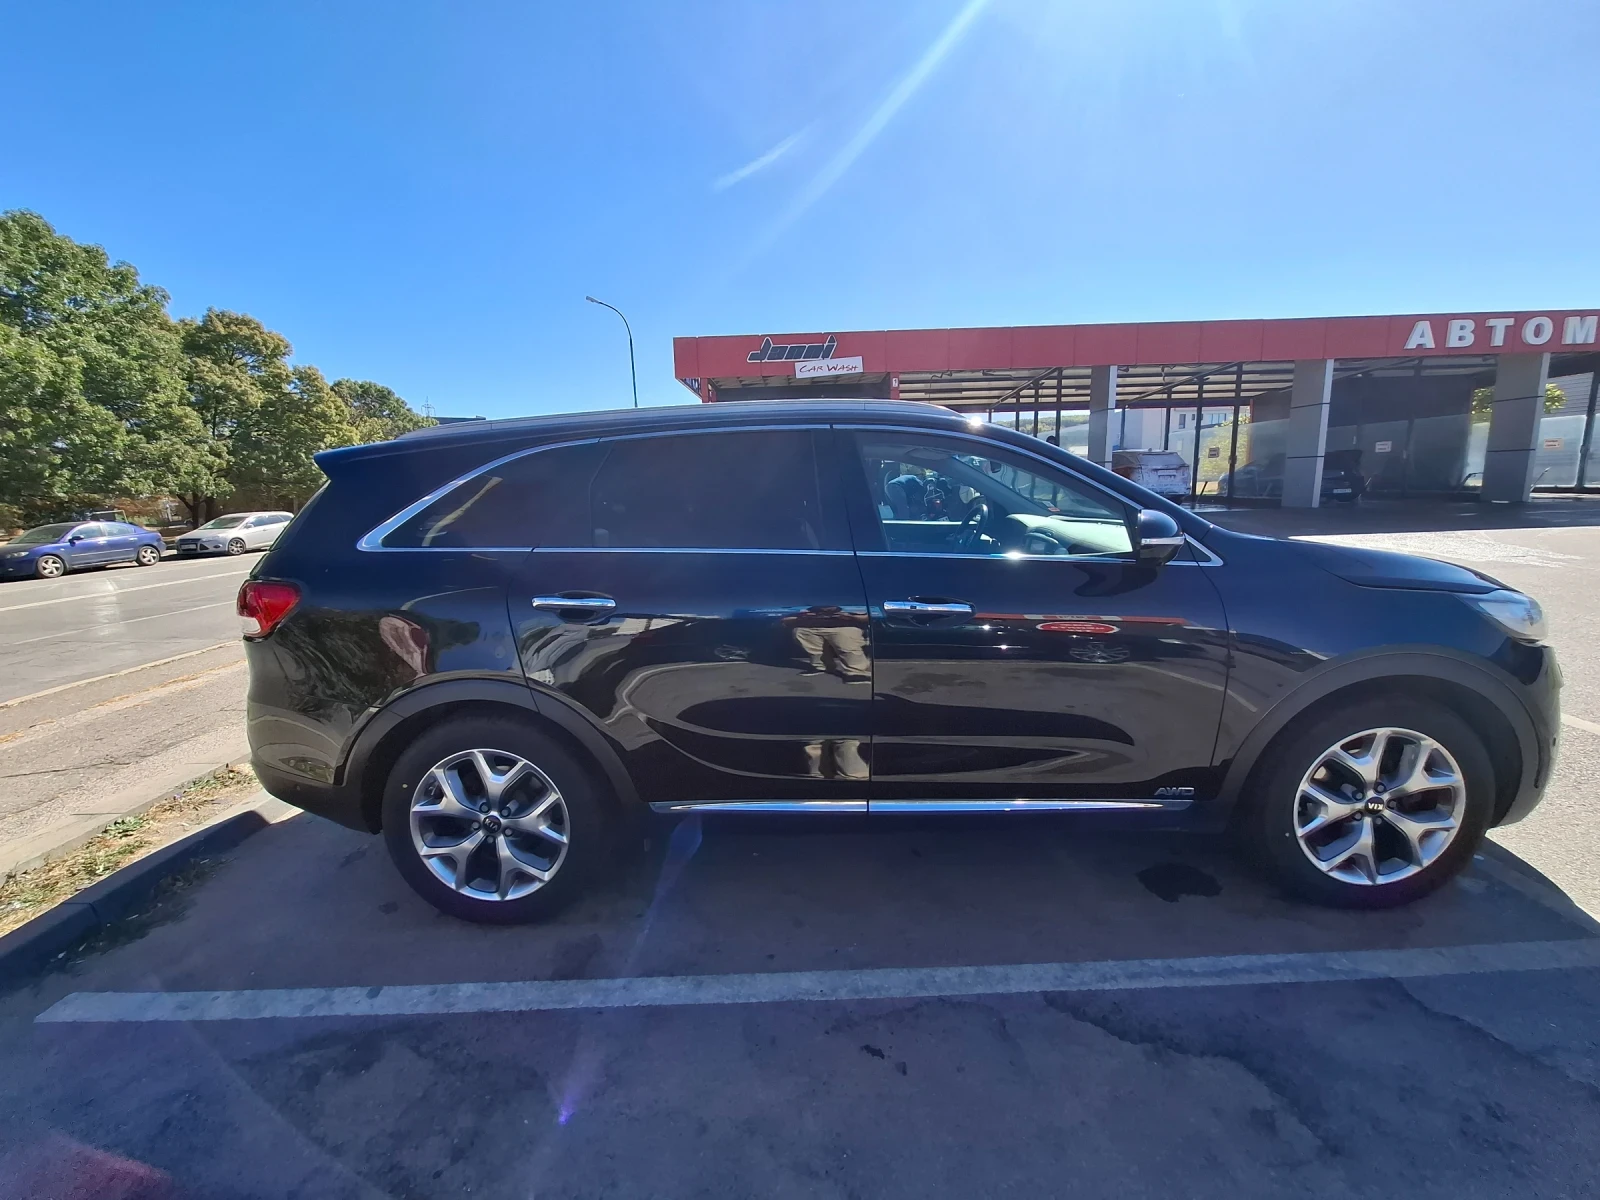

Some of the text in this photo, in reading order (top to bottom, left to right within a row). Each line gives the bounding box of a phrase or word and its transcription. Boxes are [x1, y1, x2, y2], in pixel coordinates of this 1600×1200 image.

[800, 363, 859, 373] CAR WASH
[1153, 787, 1194, 796] AWD
[1368, 802, 1384, 810] KIA
[485, 818, 498, 830] KIA
